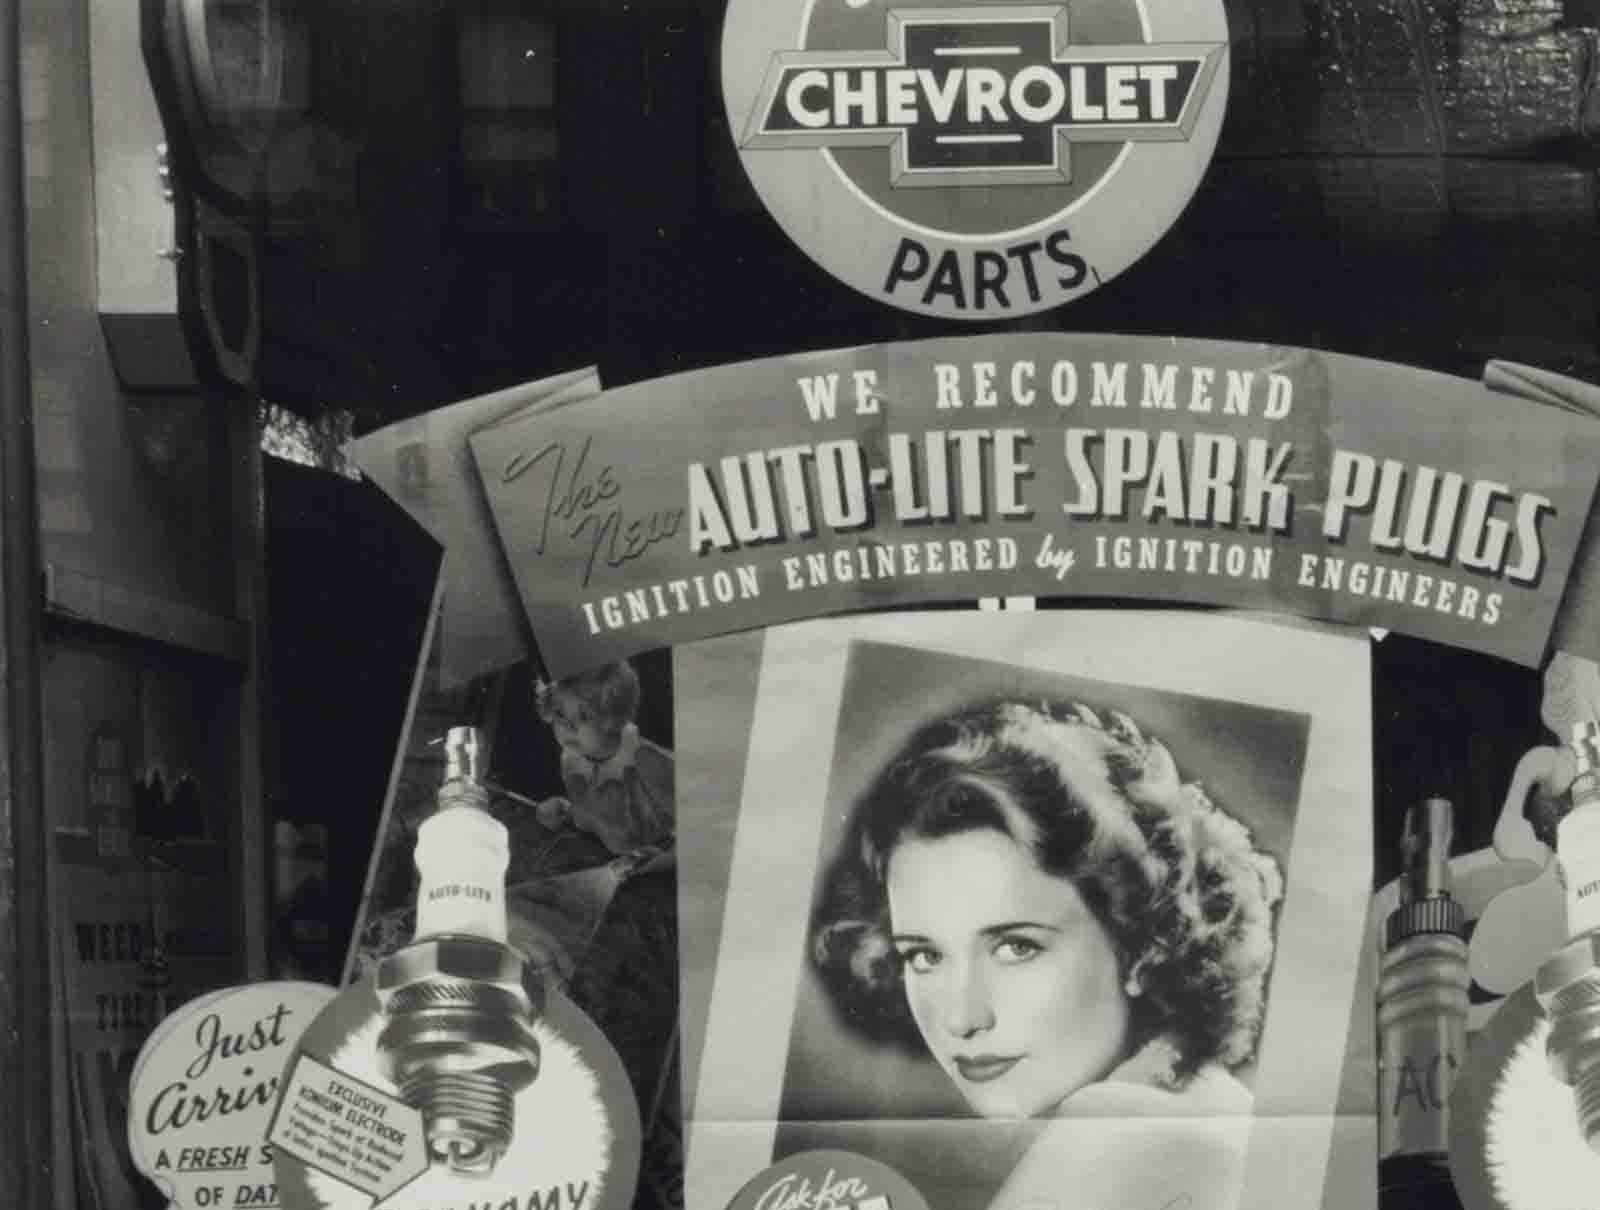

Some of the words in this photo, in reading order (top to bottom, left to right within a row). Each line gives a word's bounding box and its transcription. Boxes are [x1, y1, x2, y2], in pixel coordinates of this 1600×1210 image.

[785, 65, 1178, 127] CHEVROLET
[884, 230, 1088, 309] PARTS
[799, 370, 880, 420] WE
[936, 359, 1294, 421] RECOMMEND
[503, 436, 621, 555] The
[689, 428, 1035, 558] AUTO-LITE
[1064, 428, 1296, 536] SPARK
[1322, 449, 1556, 587] PLUGS
[570, 508, 684, 588] New
[582, 566, 761, 635] IGNITION
[784, 535, 1018, 591] ENGINEERED
[1036, 533, 1075, 580] by
[1096, 537, 1273, 580] IGNITION
[1298, 553, 1504, 626] ENGINEERS
[185, 1002, 293, 1079] Just
[154, 1149, 171, 1169] A
[177, 1145, 249, 1170] FRESH
[194, 1186, 224, 1207] OF
